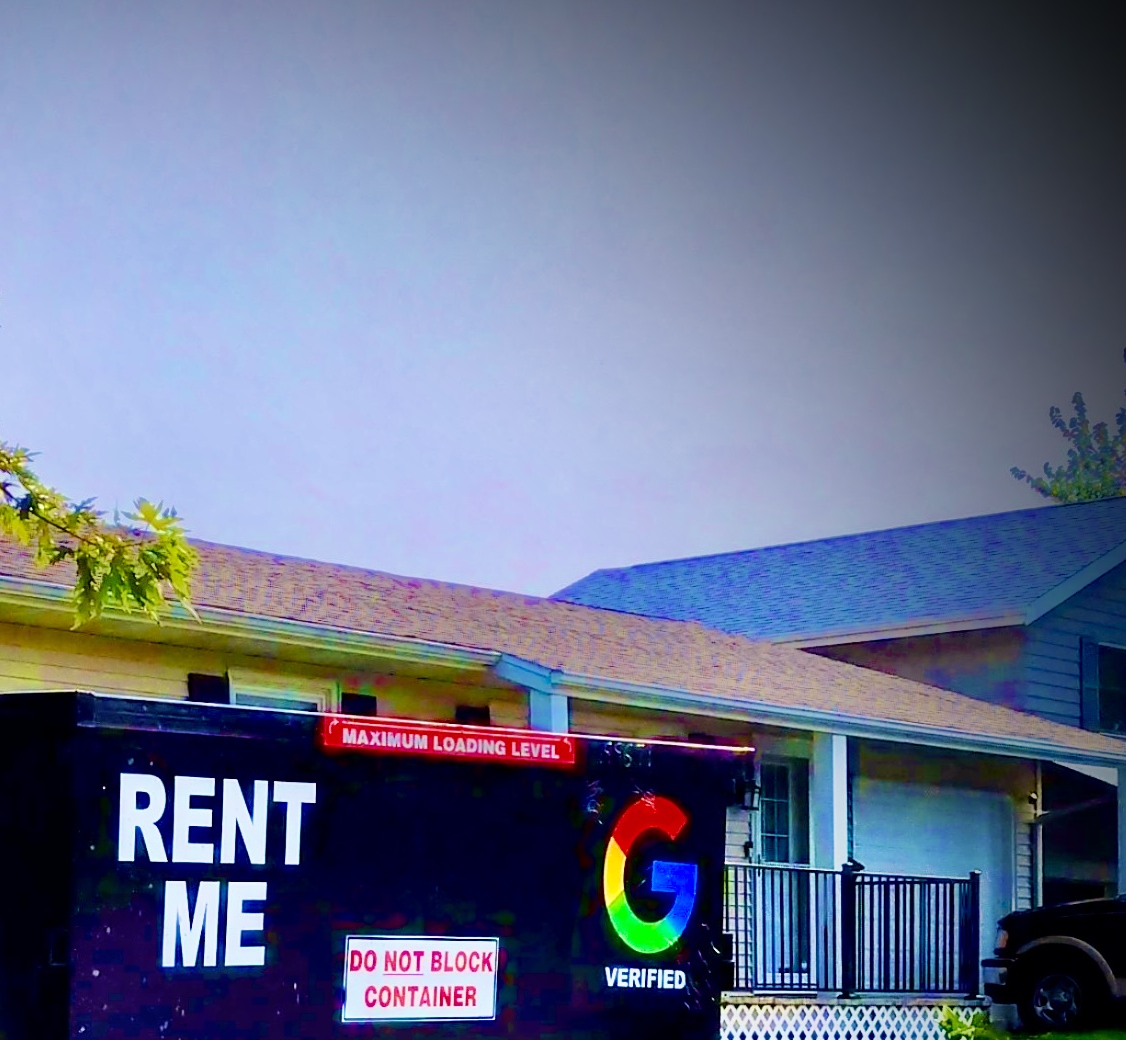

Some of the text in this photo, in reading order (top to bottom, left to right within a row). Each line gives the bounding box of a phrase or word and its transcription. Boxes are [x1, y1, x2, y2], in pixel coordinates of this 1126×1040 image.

[342, 728, 560, 759] MAXIMUM LOADING LEVEL
[118, 772, 316, 866] RENT
[162, 880, 267, 968] ME
[349, 948, 493, 975] DO NOT BLOCK
[605, 966, 686, 989] VERIFIED
[364, 985, 477, 1008] CONTAINER
